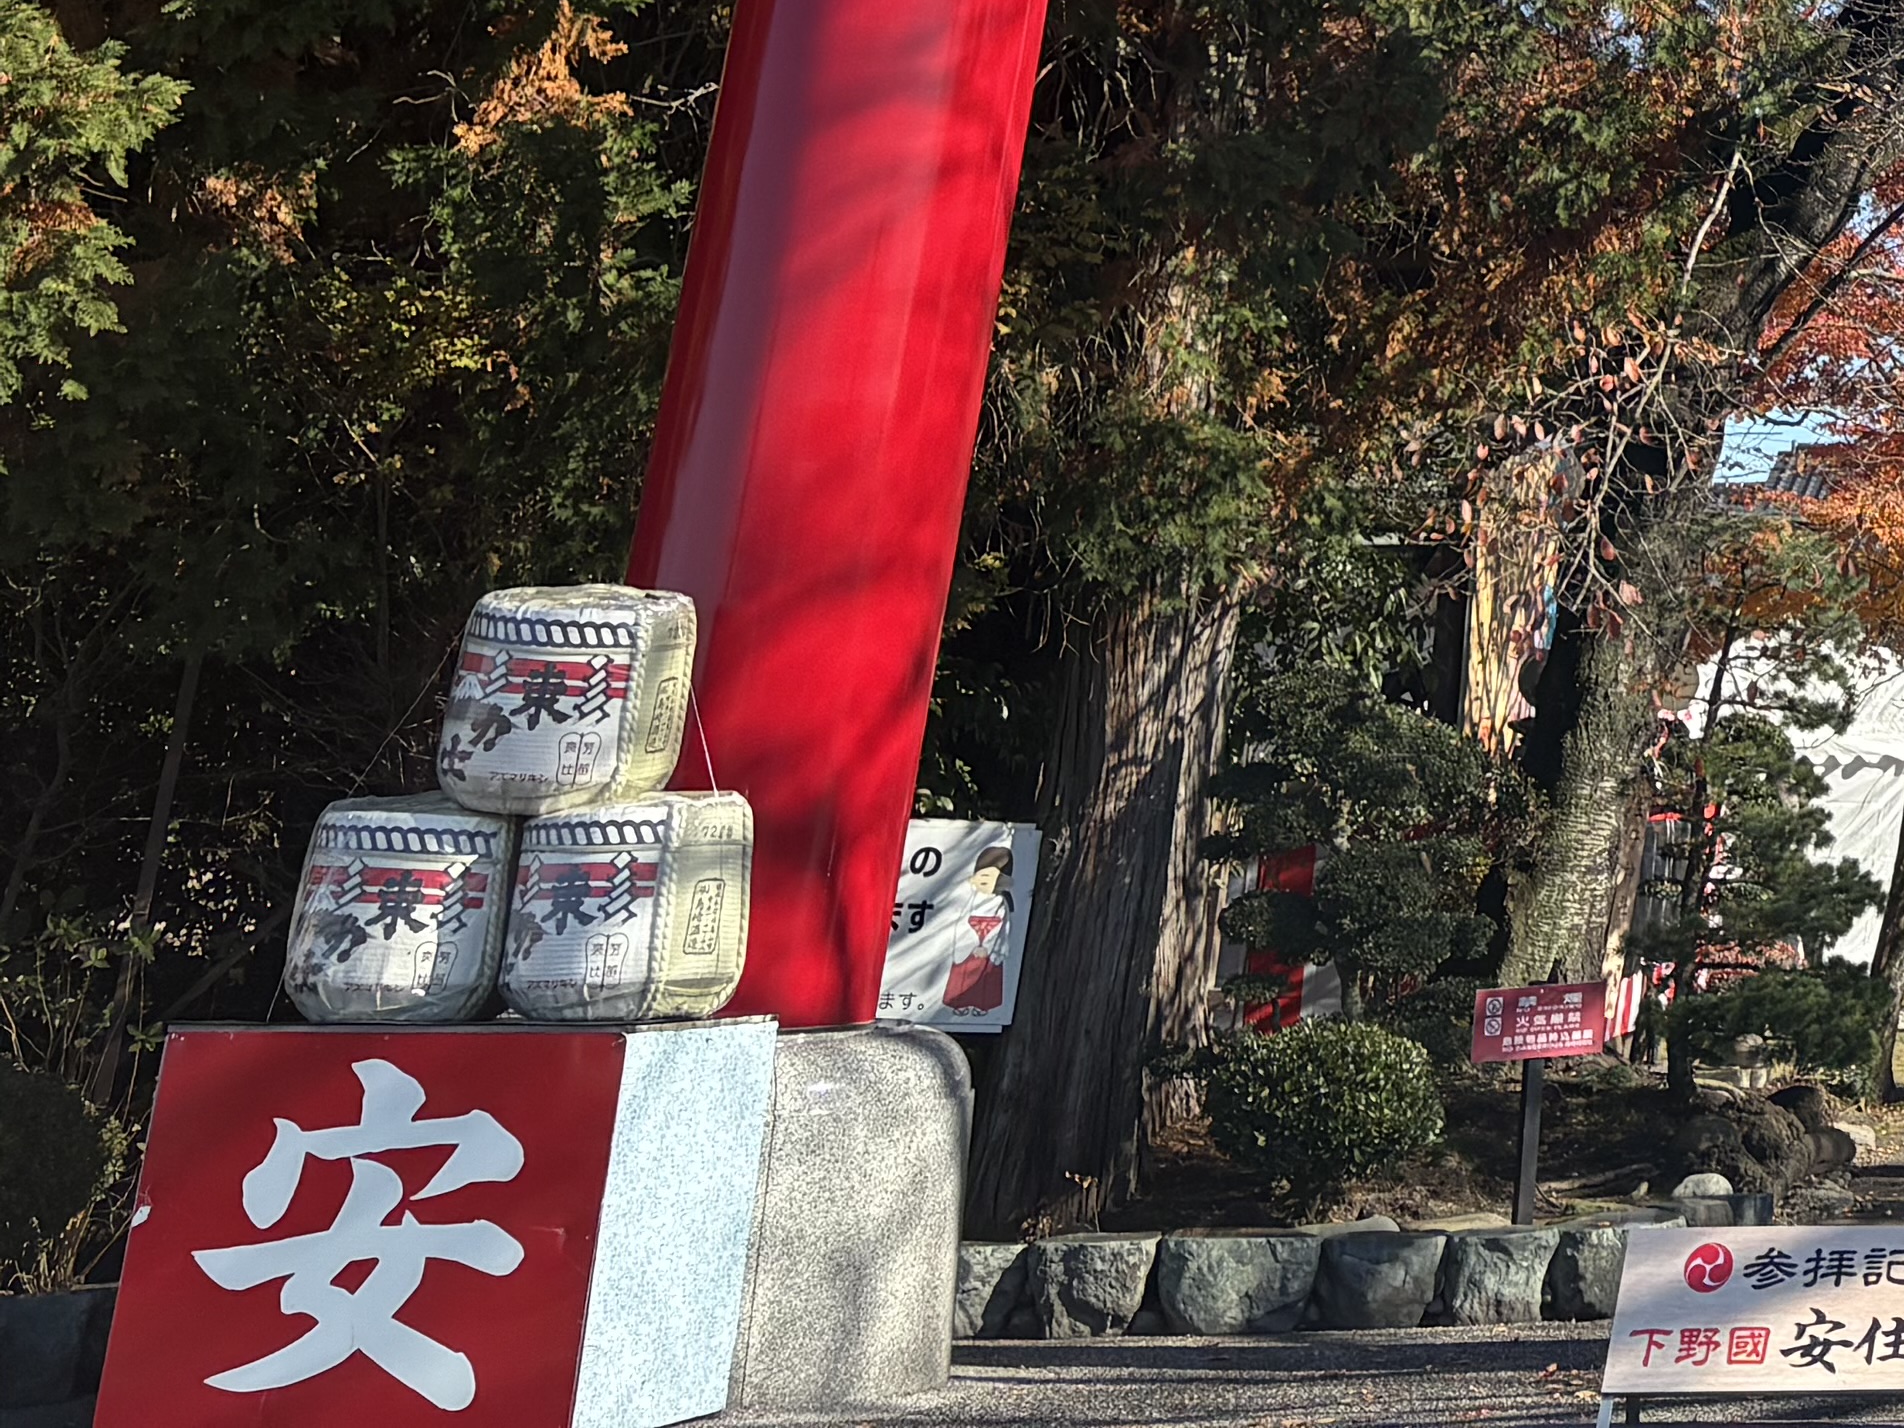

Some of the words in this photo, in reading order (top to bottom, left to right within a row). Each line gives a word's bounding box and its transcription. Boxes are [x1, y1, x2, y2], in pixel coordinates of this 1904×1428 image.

[909, 846, 943, 878] の
[191, 1058, 525, 1412] 安
[1629, 1326, 1771, 1368] 下野國
